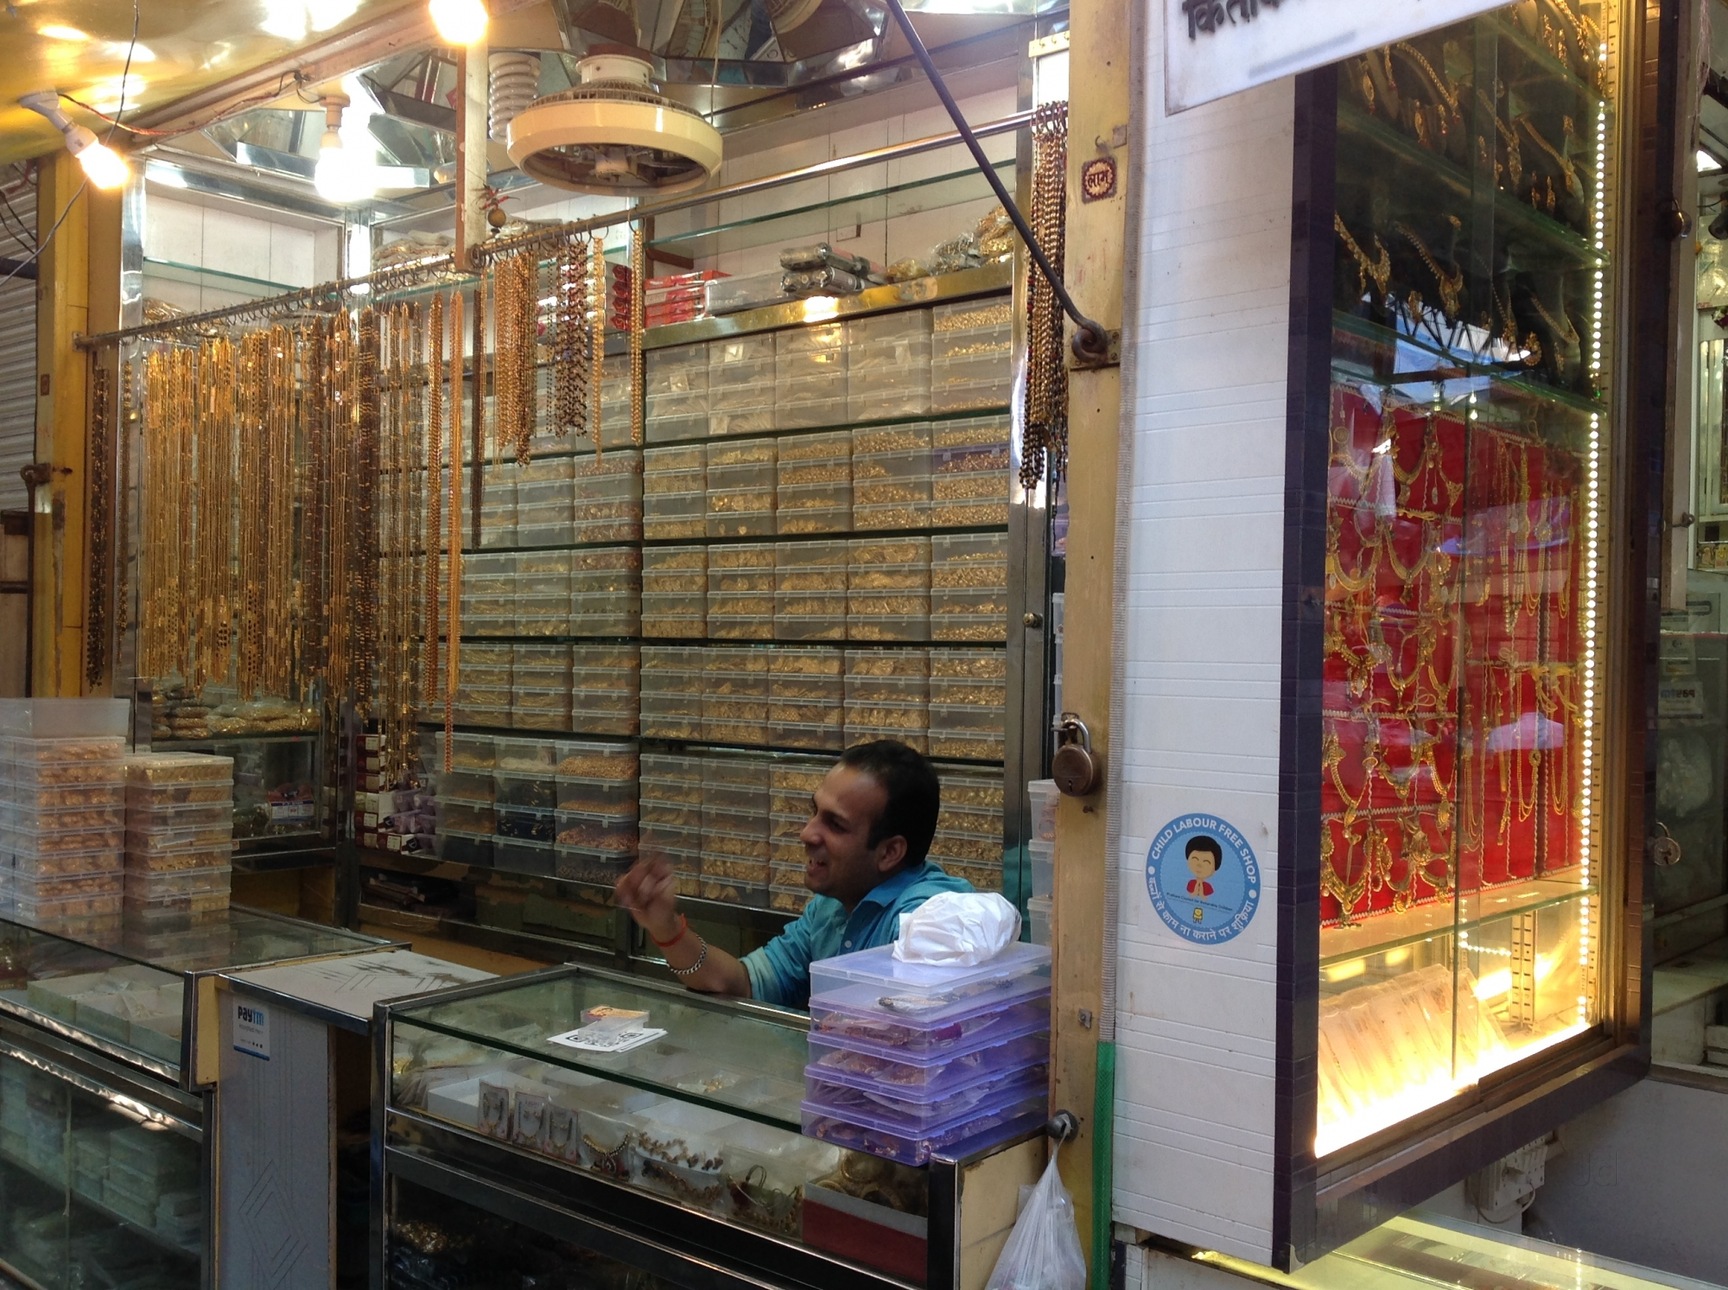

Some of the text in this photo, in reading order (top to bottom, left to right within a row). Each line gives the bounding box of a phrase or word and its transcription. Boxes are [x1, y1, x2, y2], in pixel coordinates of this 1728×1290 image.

[1152, 817, 1256, 884] CHILD LABOUR FREE SHOP
[1149, 876, 1162, 899] बच्चों
[1155, 901, 1165, 911] से
[1162, 910, 1179, 929] काम
[1180, 924, 1191, 936] ना
[1192, 927, 1217, 940] कराने
[1218, 927, 1232, 938] पर
